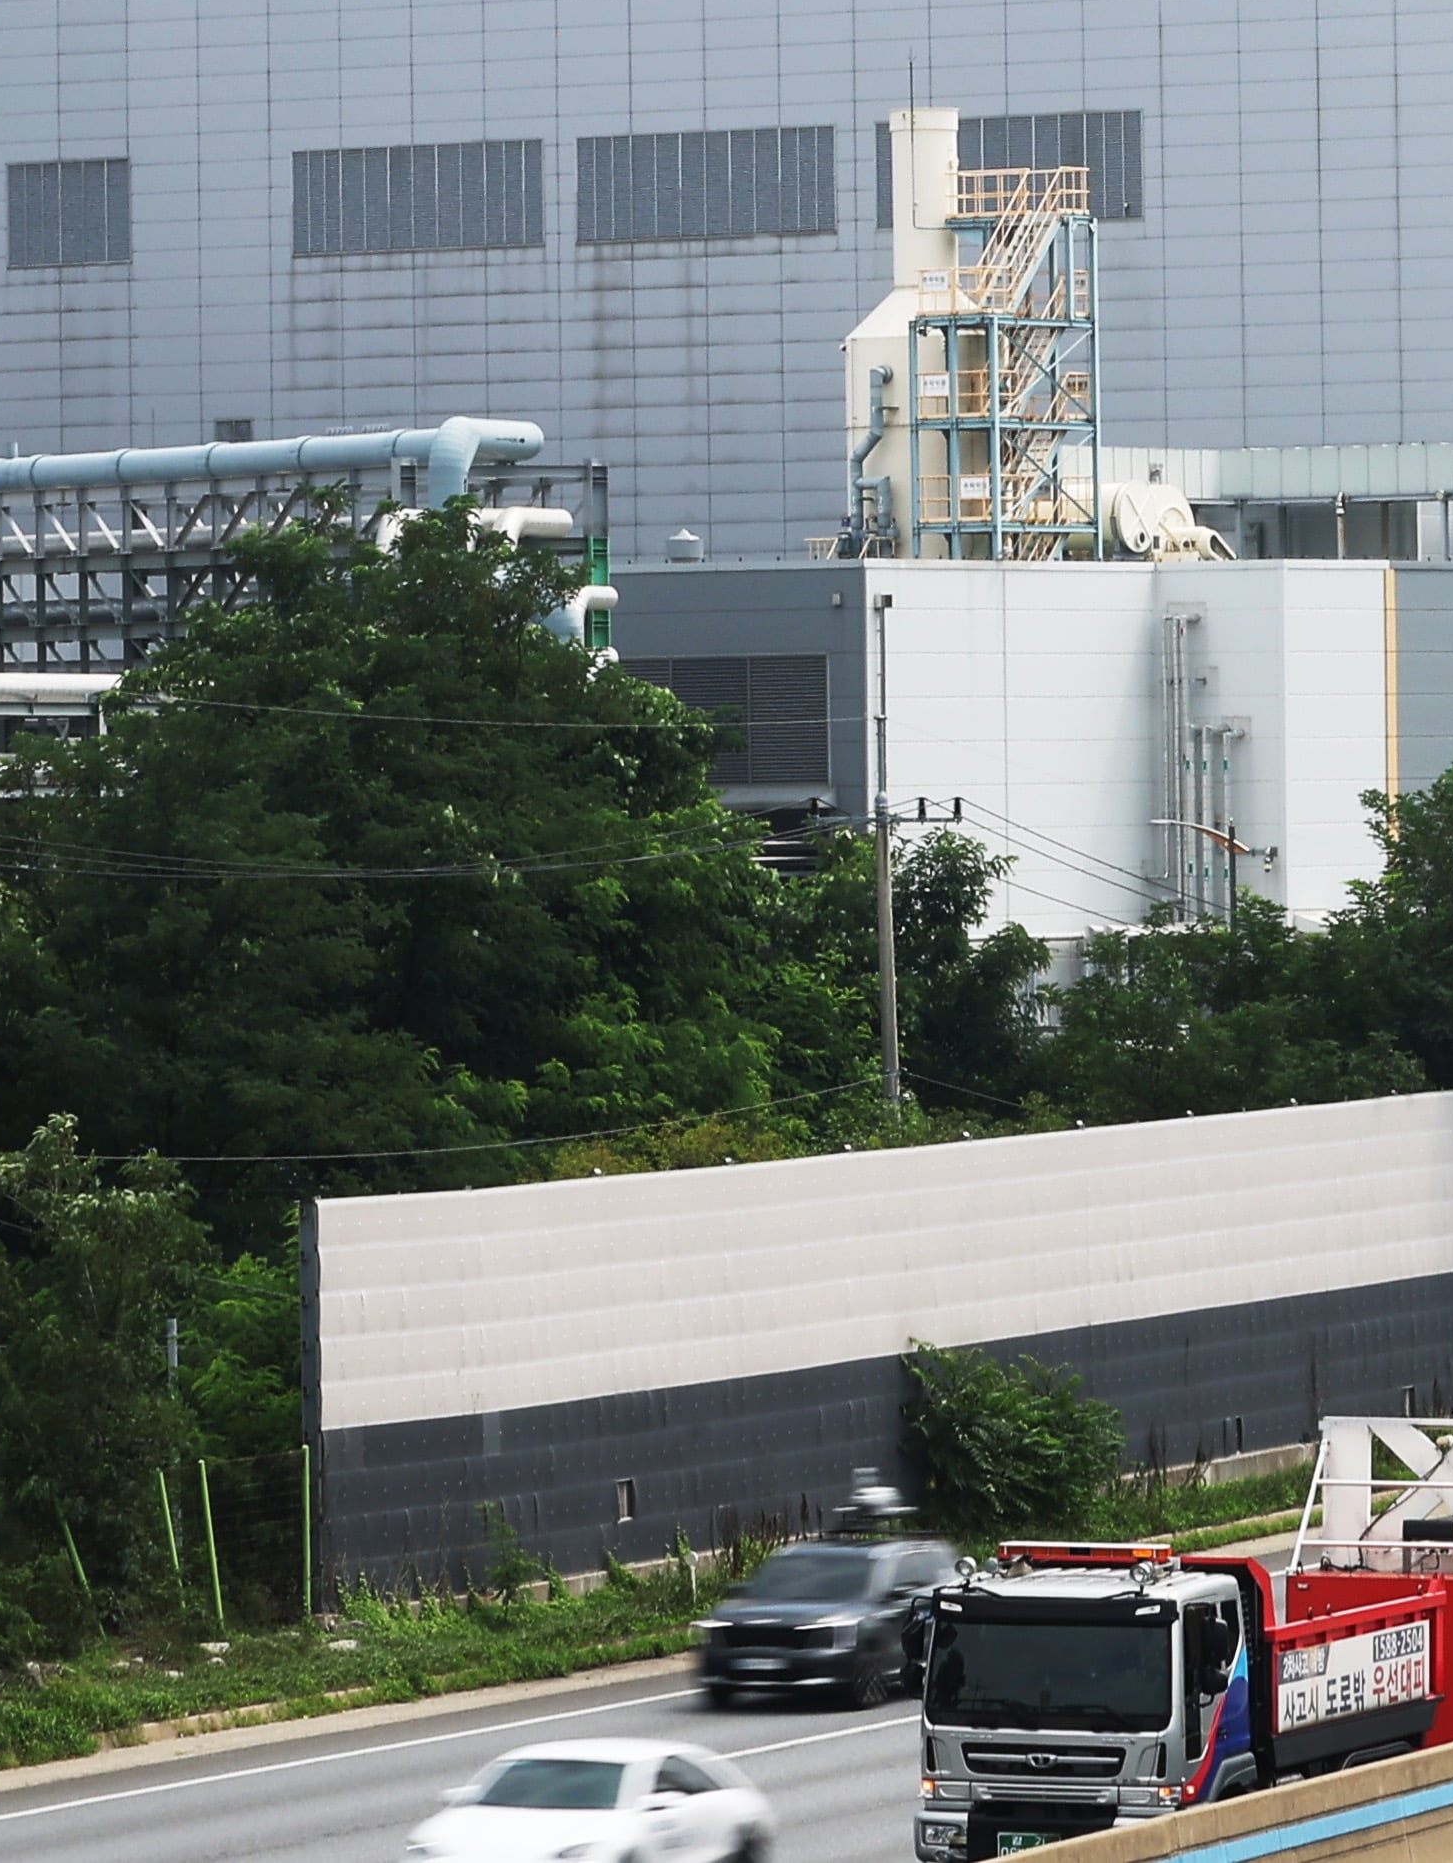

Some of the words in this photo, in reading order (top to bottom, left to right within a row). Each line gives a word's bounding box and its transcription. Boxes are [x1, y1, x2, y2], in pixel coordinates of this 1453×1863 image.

[1284, 1685, 1319, 1727] 사고시
[1326, 1669, 1365, 1715] 도로밖
[1373, 1657, 1424, 1707] 우선대피
